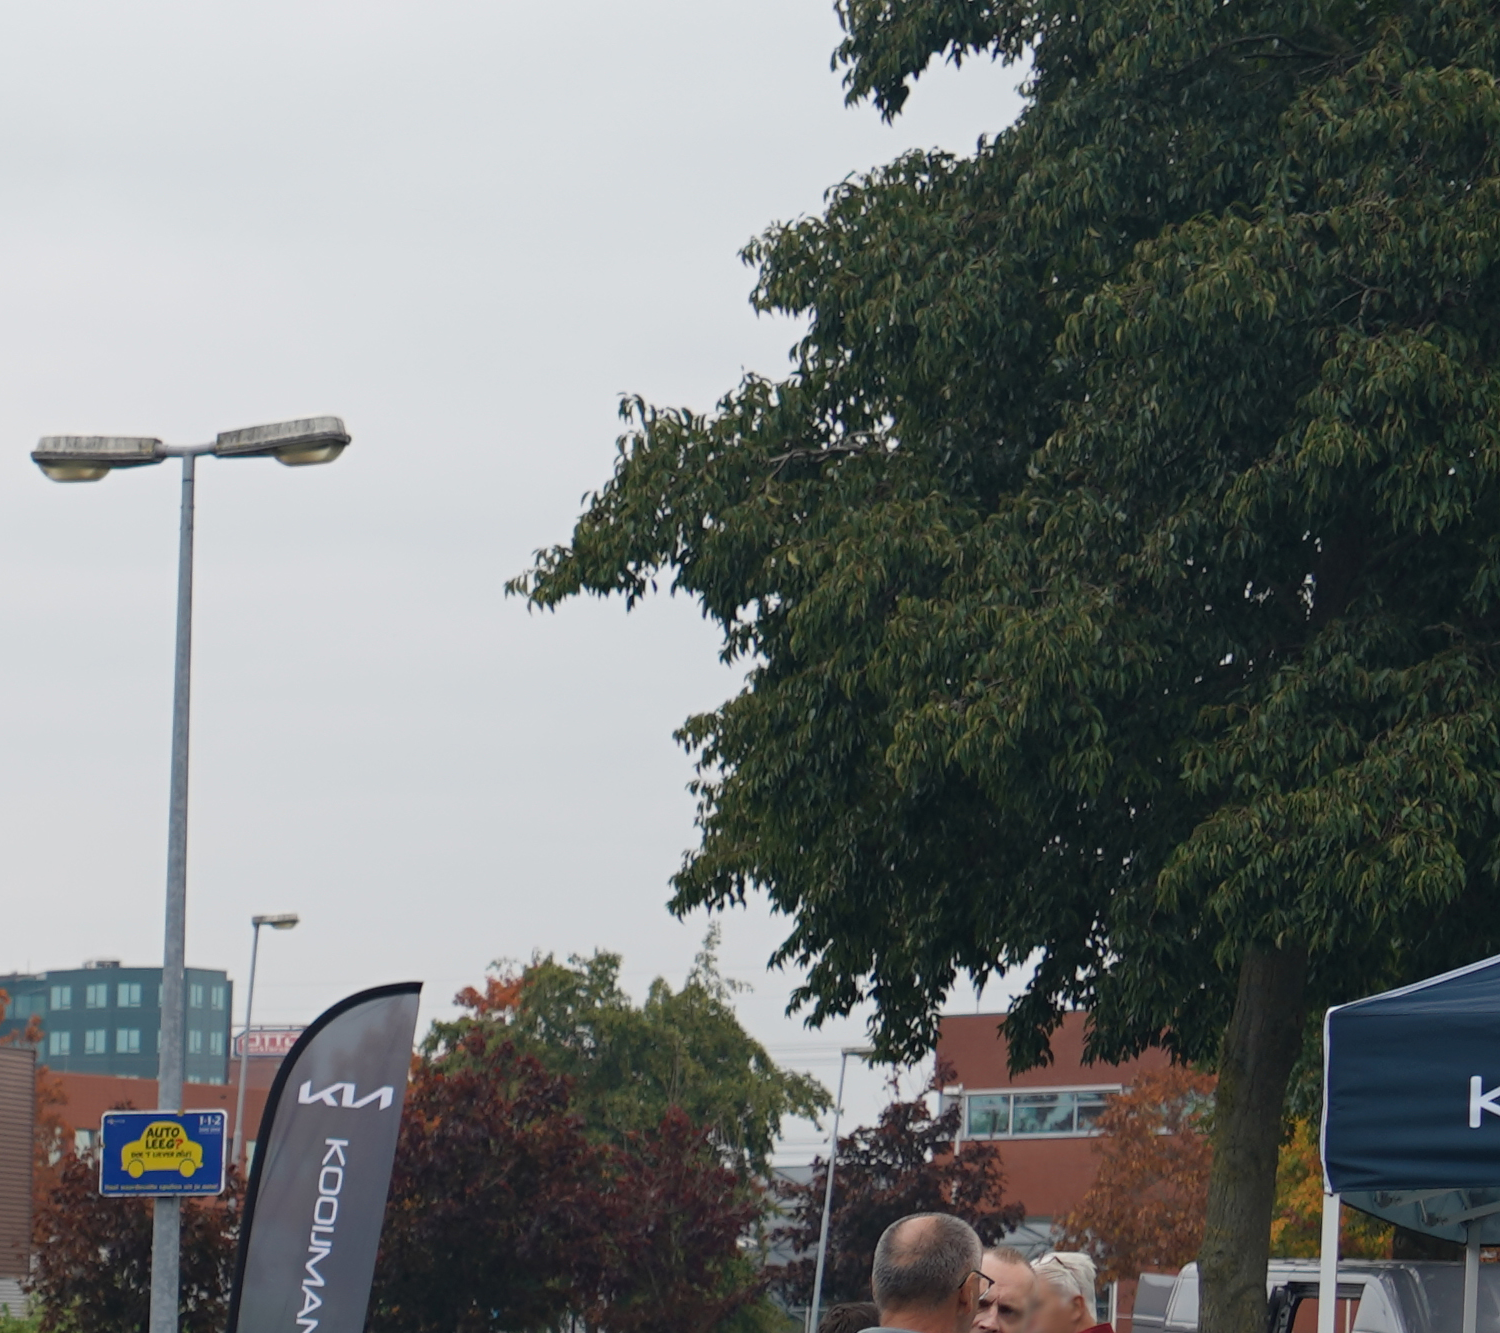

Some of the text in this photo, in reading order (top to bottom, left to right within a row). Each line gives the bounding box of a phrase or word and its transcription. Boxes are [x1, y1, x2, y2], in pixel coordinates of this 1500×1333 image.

[298, 1080, 394, 1111] KIA
[147, 1127, 180, 1138] AUTO
[145, 1138, 184, 1150] LEEG?
